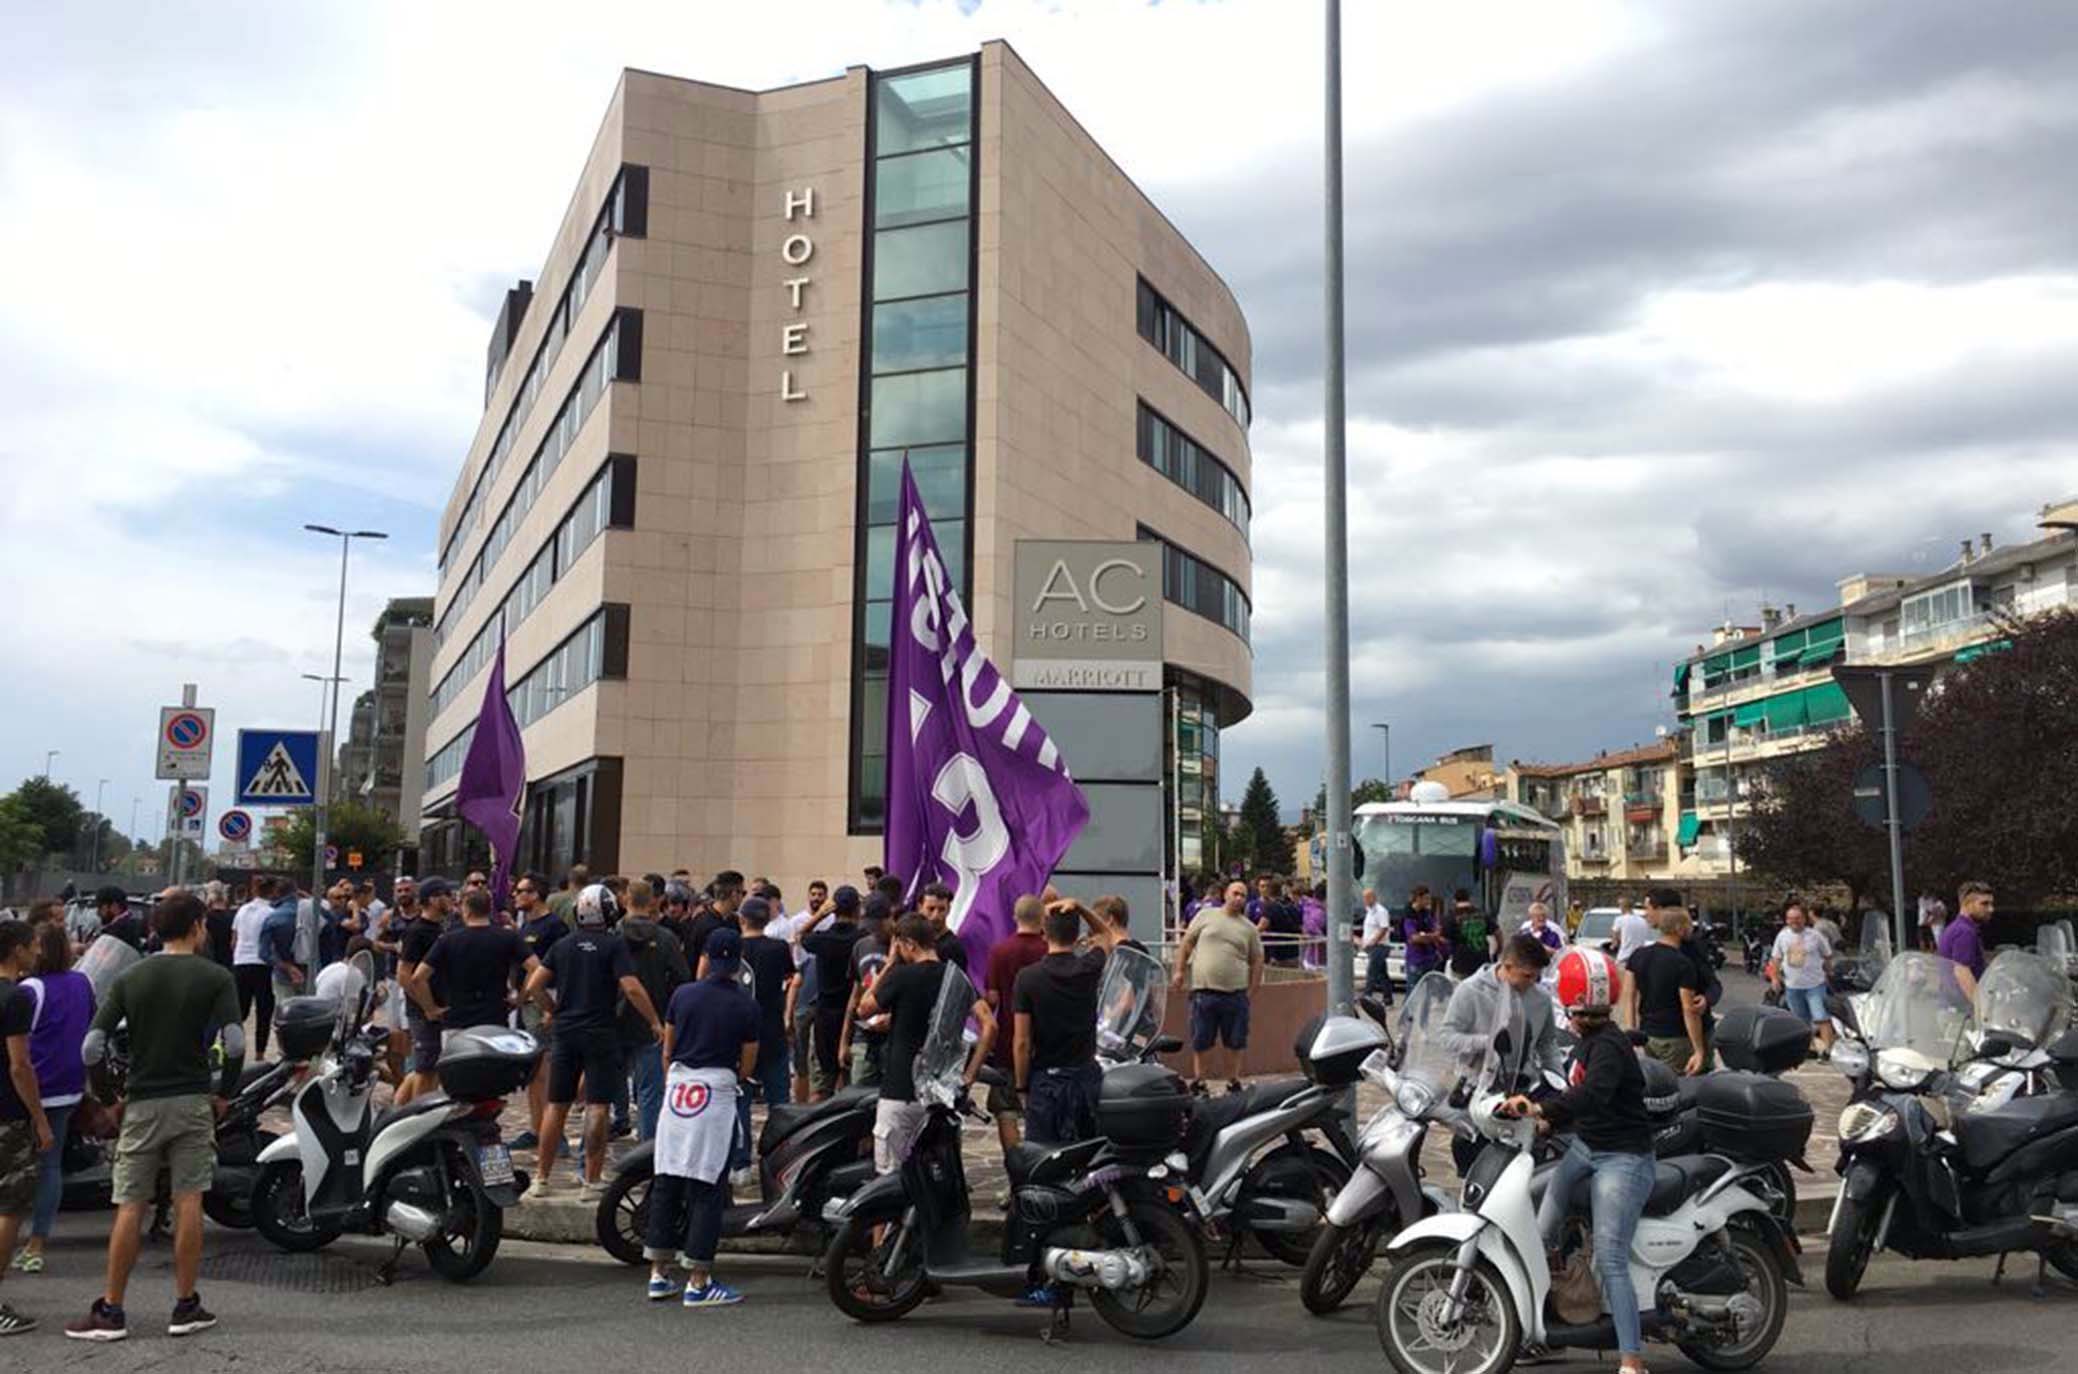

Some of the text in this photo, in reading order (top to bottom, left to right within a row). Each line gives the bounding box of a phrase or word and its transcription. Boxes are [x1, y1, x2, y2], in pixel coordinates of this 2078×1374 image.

[782, 187, 814, 401] HOTEL
[1032, 559, 1145, 616] AC
[1030, 622, 1148, 641] HOTELS
[1033, 665, 1147, 687] MARRIOTT
[1440, 816, 1458, 825] BUS
[675, 1082, 706, 1110] 10
